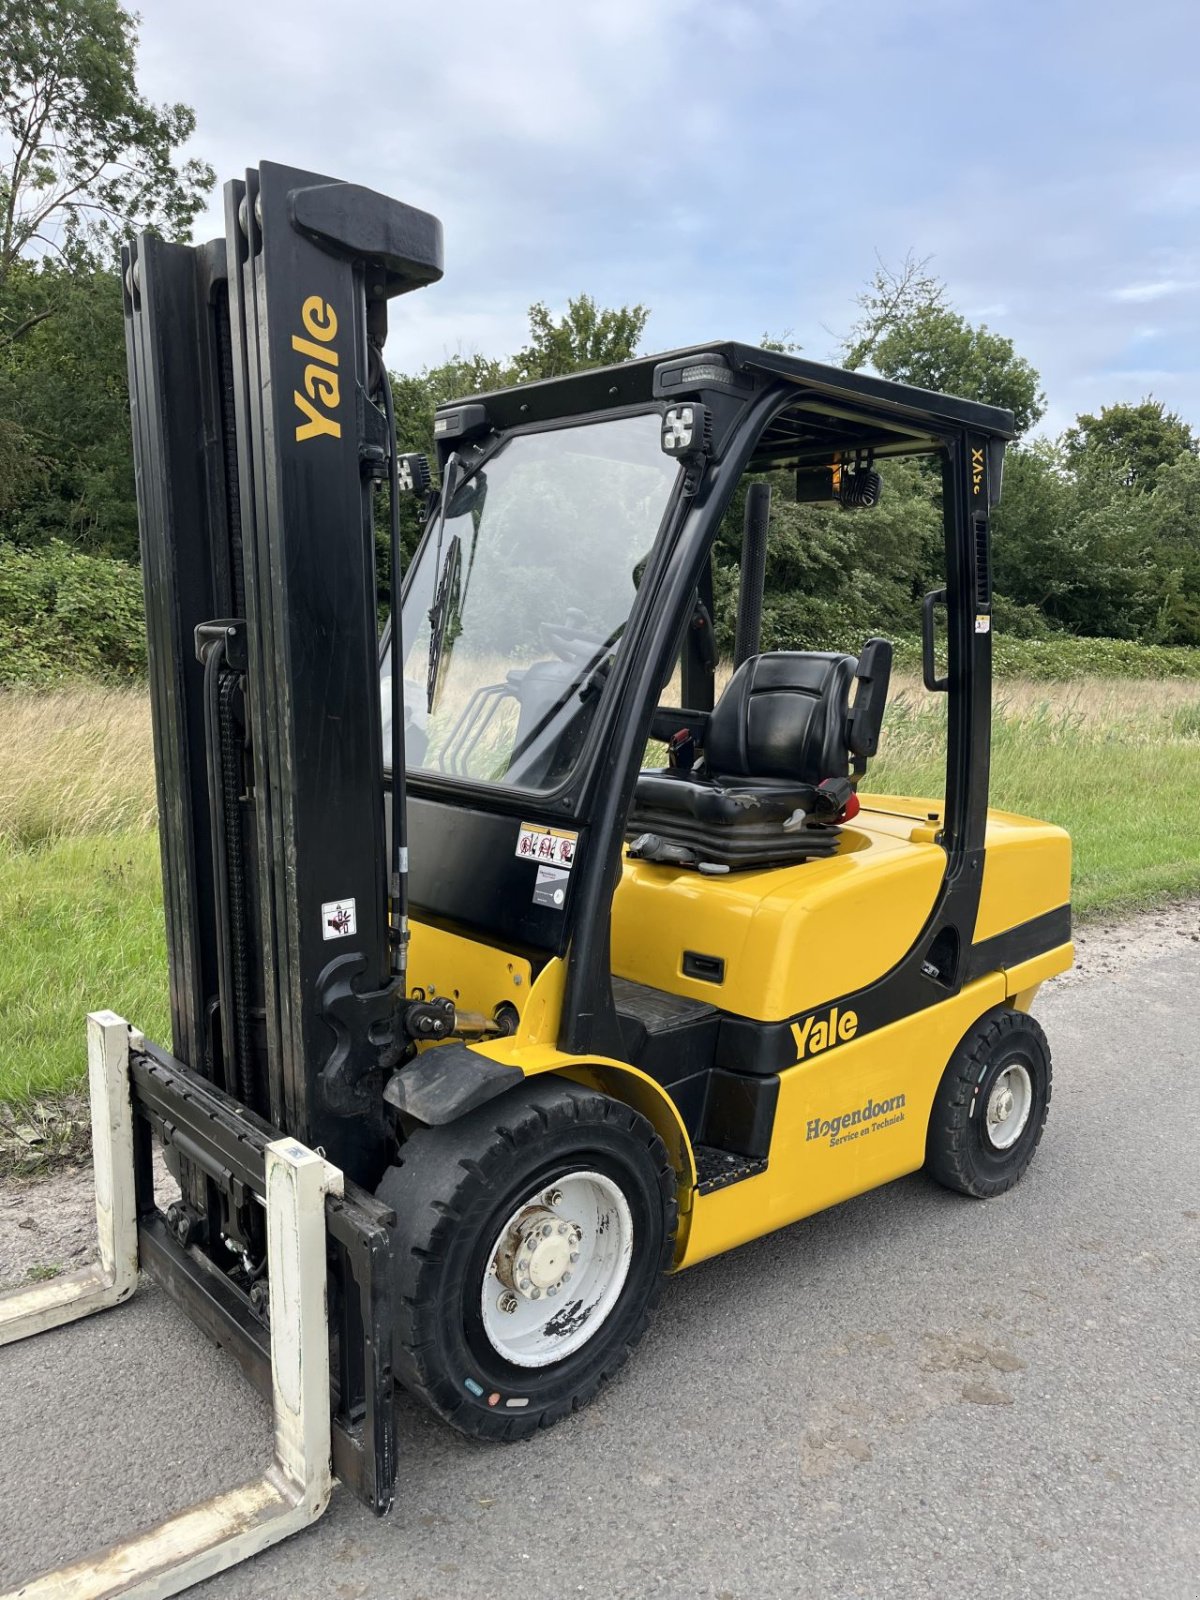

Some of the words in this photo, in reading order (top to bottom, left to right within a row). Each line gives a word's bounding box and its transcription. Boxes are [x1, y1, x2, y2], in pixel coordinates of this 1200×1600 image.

[292, 295, 341, 442] Yale
[790, 1007, 858, 1060] Yale
[806, 1093, 906, 1142] Hogendoorn
[829, 1130, 859, 1147] Service
[860, 1127, 870, 1136] en
[871, 1112, 905, 1132] Techniek
